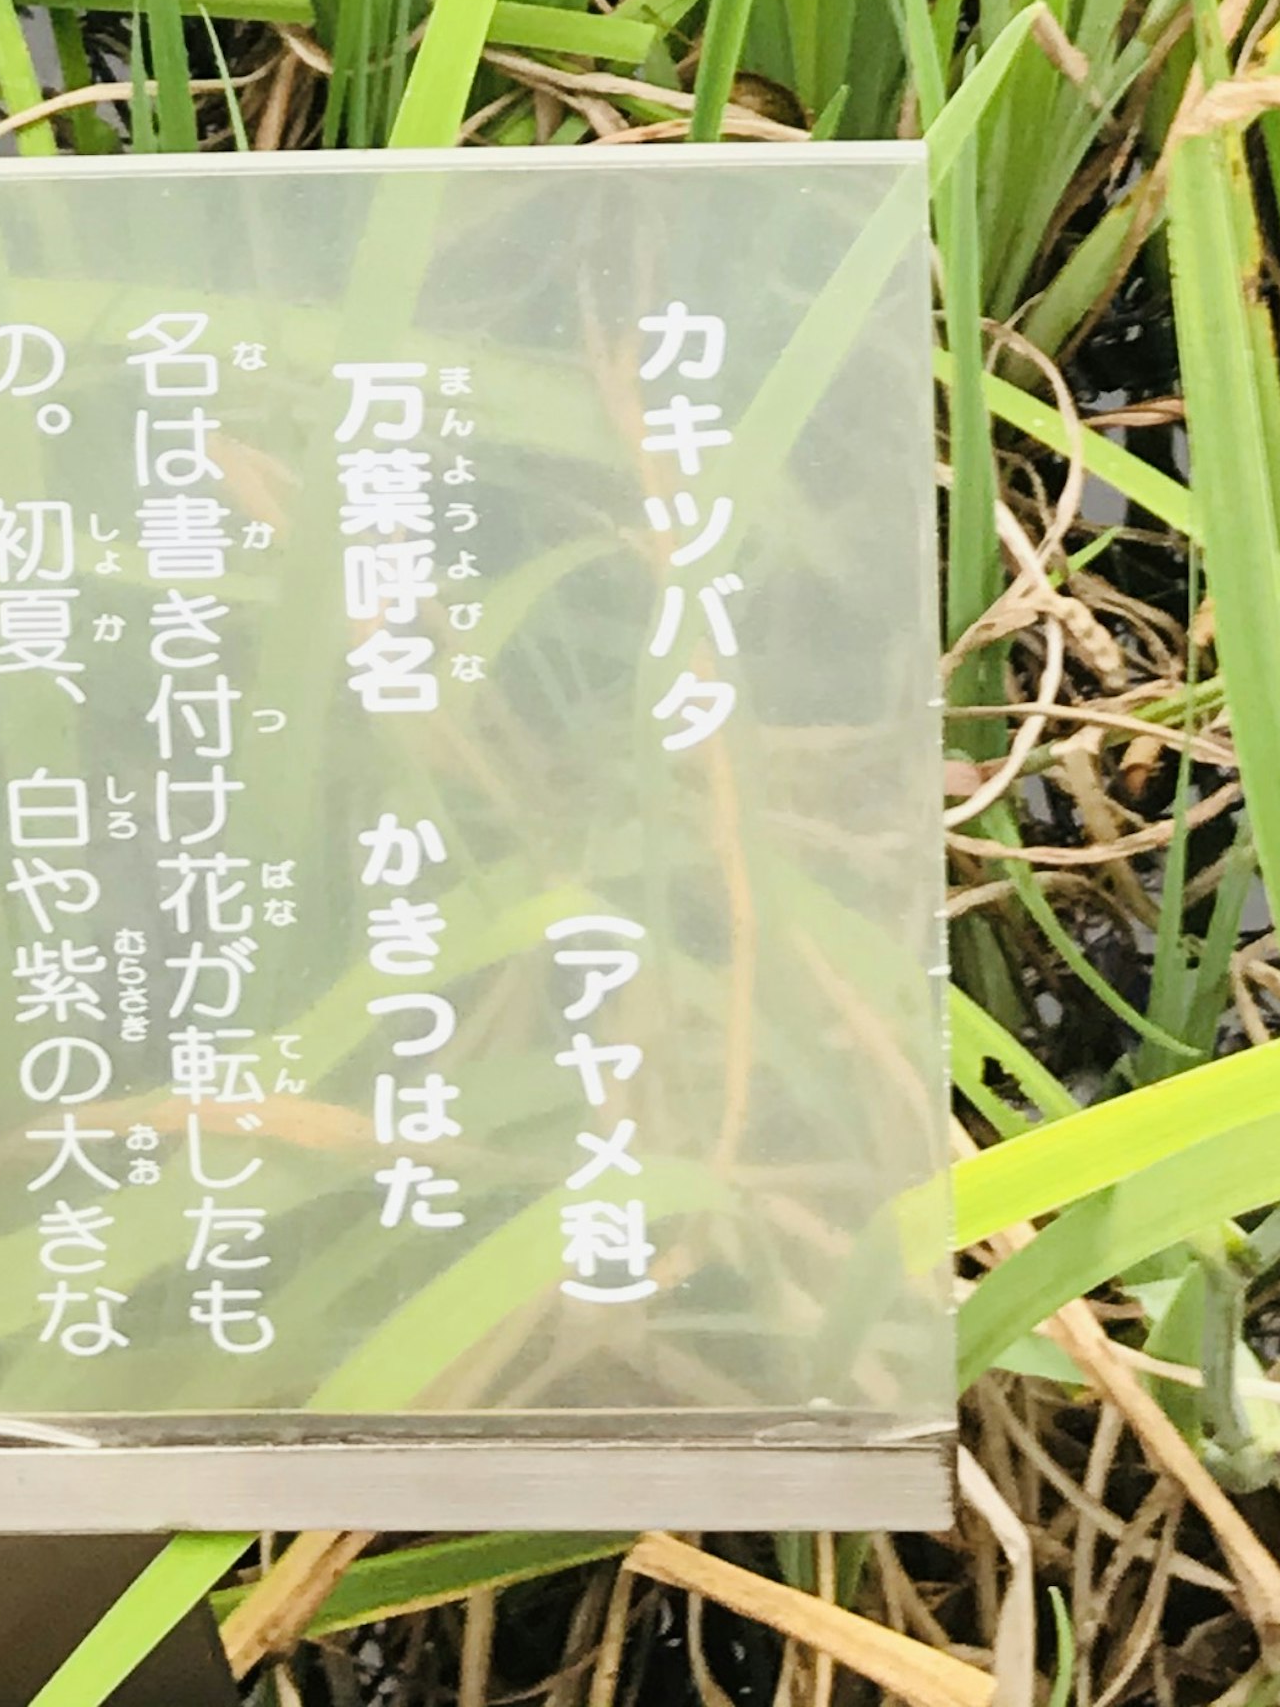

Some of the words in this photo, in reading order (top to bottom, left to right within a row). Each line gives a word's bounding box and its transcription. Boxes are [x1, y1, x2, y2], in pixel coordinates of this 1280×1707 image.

[233, 341, 267, 371] な
[243, 521, 275, 550] か
[332, 362, 440, 713] 万葉呼名
[439, 366, 486, 683] まんようよびな
[638, 300, 742, 750] カキツバタ
[106, 775, 138, 841] しろ
[126, 312, 276, 1354] 名は書き付け花が転じたも
[261, 860, 297, 927] ばな
[113, 928, 150, 1043] むらさき
[358, 813, 464, 1228] かきつはた
[272, 1034, 306, 1095] てん
[125, 1123, 161, 1186] おお
